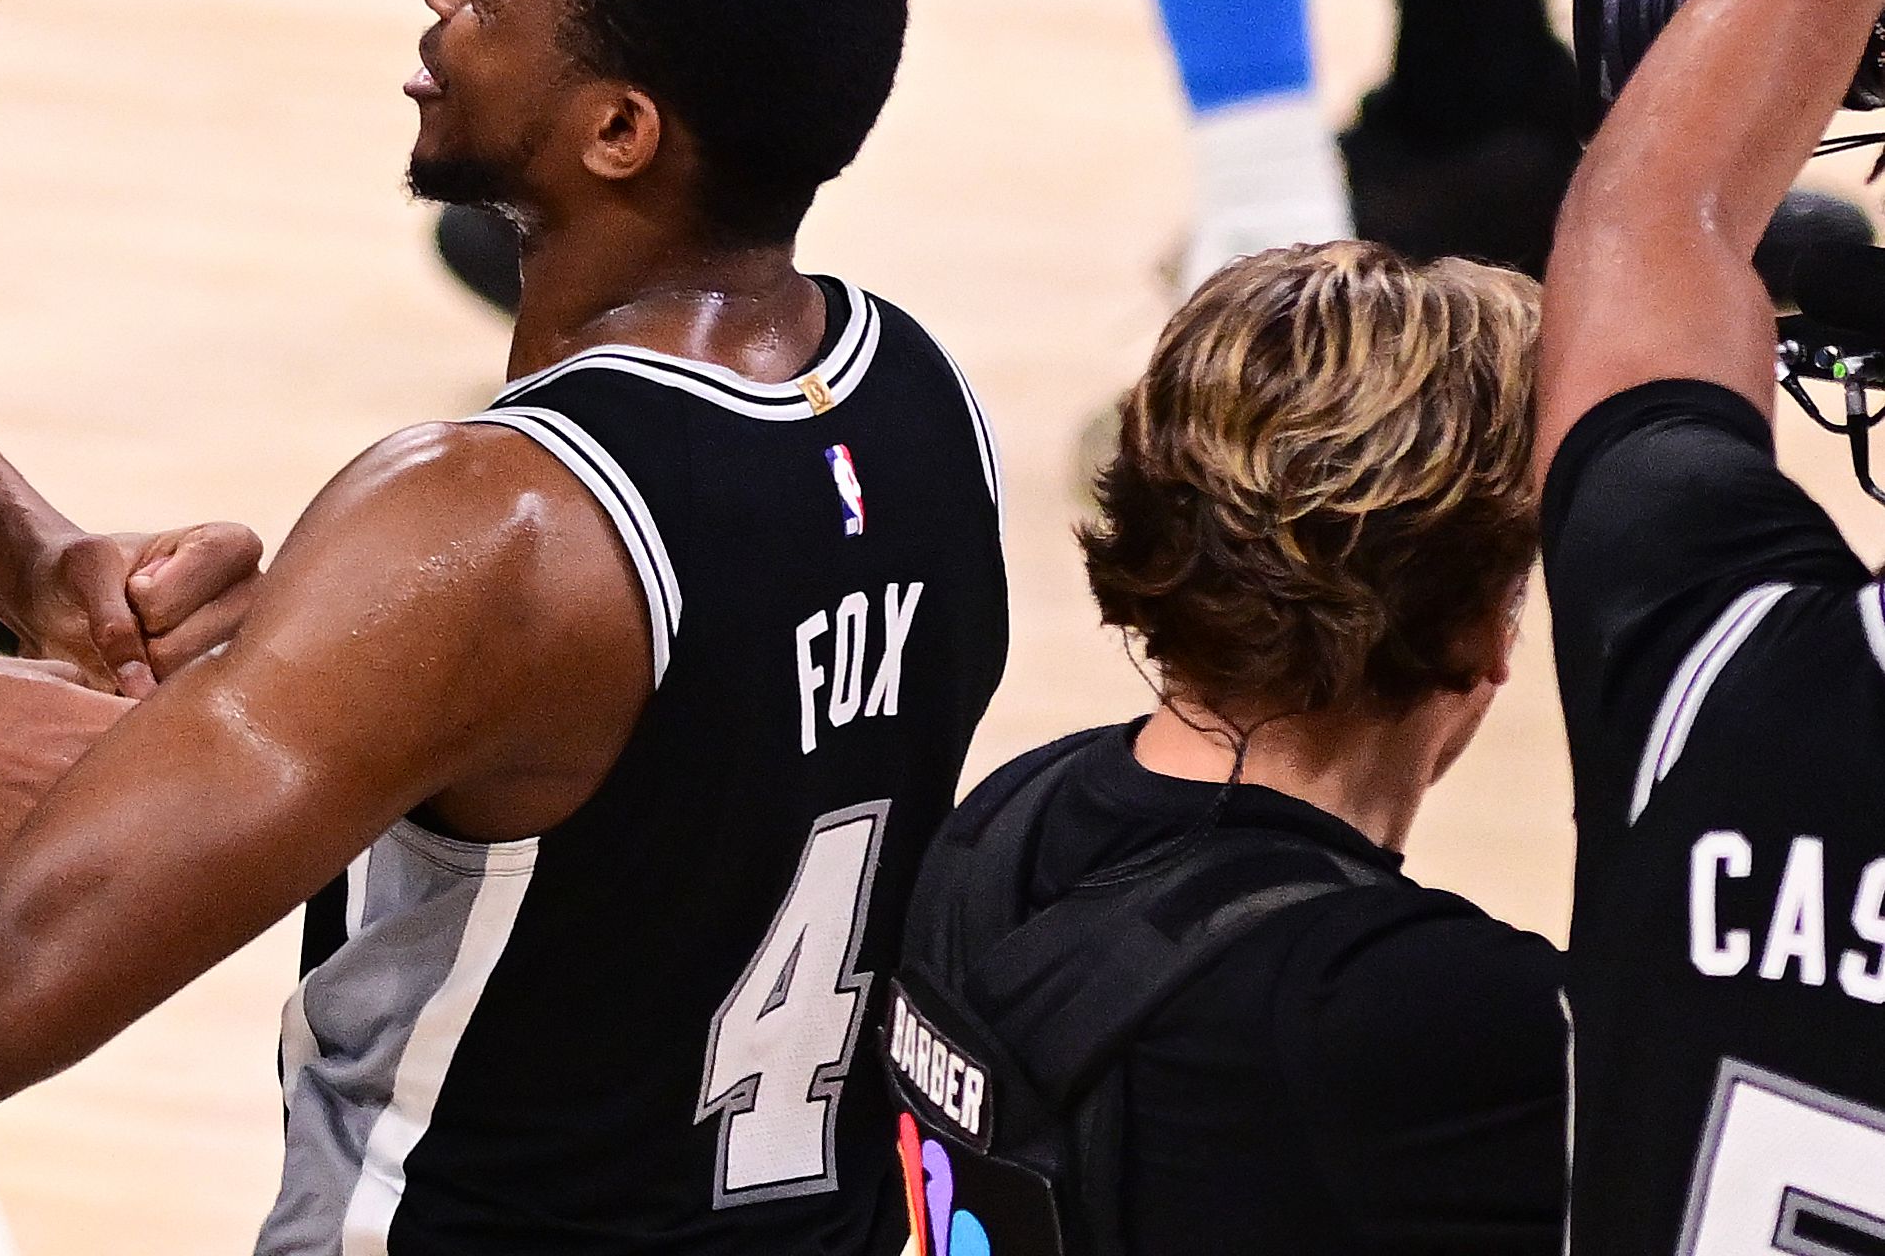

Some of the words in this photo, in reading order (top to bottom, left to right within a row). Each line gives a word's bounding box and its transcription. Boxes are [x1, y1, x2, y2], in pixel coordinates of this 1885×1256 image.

[795, 581, 924, 755] FOX
[693, 798, 893, 1211] 4
[890, 996, 985, 1135] BARBER
